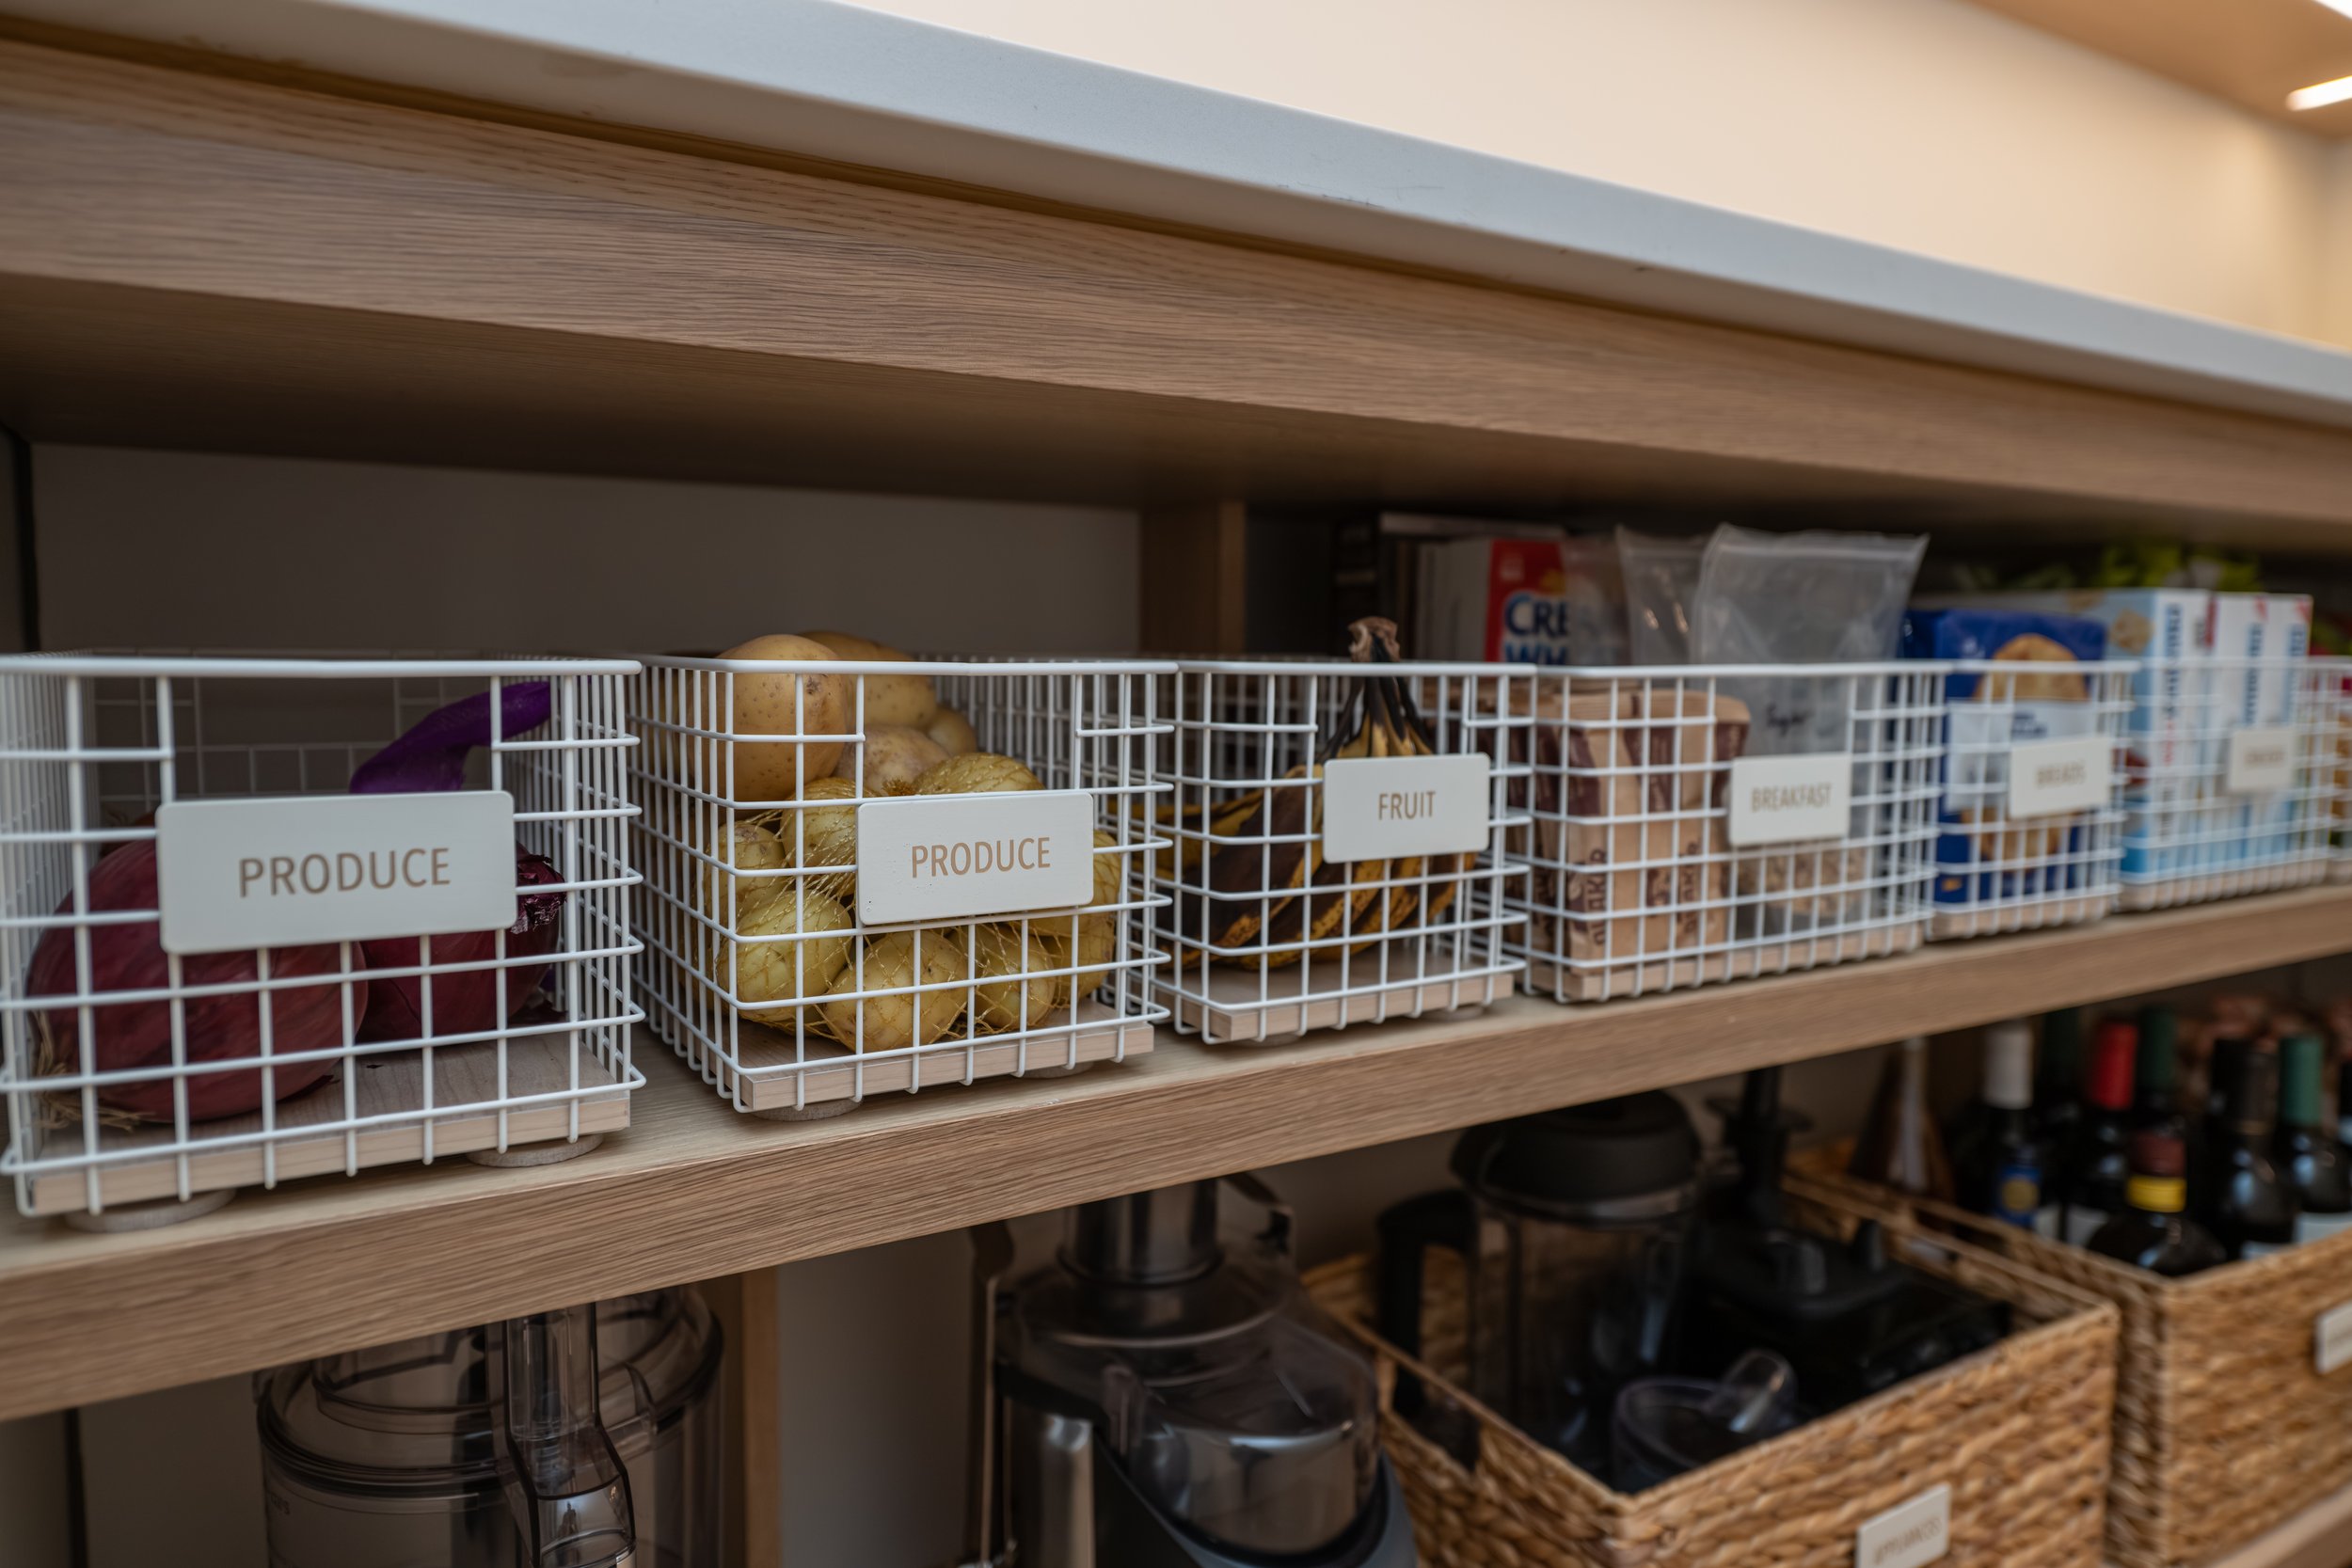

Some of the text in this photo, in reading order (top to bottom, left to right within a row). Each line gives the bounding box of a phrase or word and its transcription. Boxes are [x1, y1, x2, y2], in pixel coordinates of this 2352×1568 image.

[1378, 791, 1437, 820] FRUIT
[1751, 783, 1832, 812] BREAKFAST
[239, 847, 451, 898] PRODUCE
[912, 836, 1051, 879] PRODUCE
